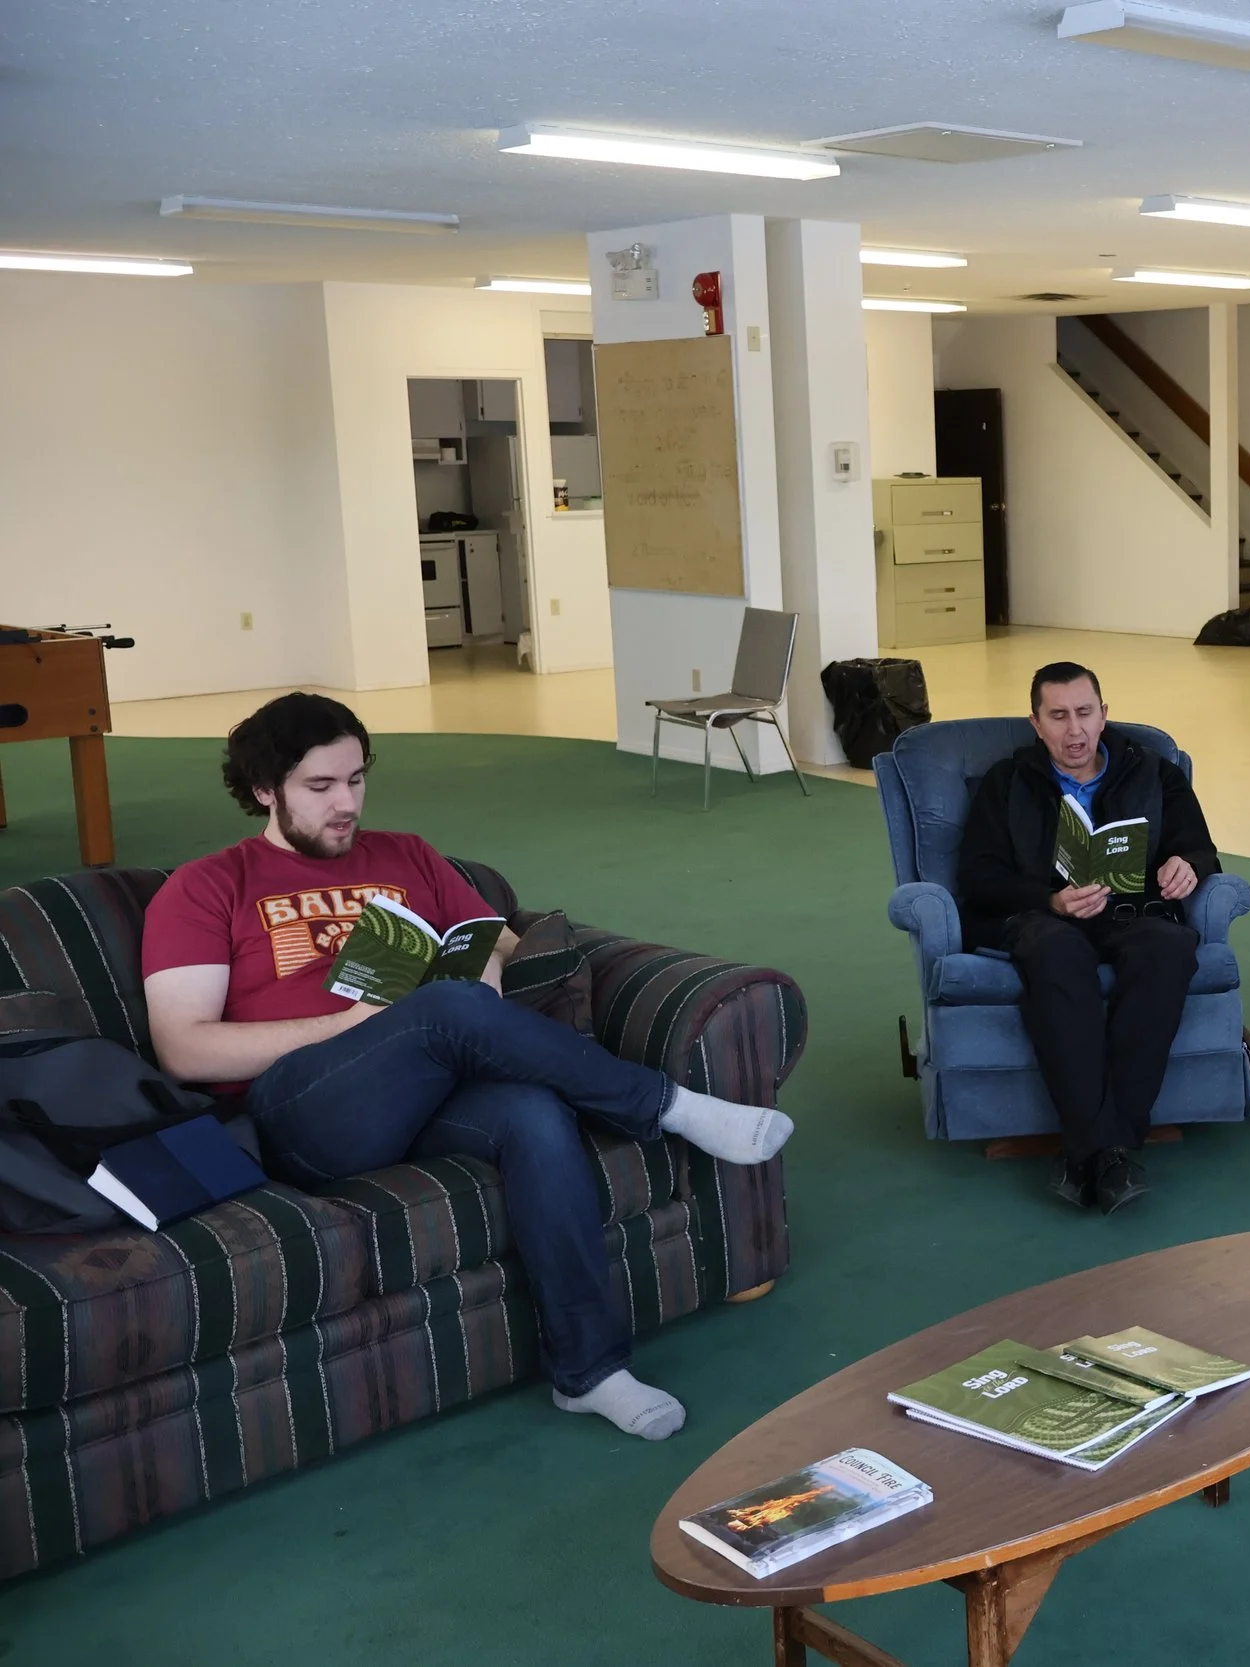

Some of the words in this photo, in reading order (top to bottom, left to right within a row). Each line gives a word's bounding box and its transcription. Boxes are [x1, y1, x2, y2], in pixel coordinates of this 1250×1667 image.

[1108, 836, 1128, 846] Sing
[1106, 845, 1129, 855] LORD
[448, 932, 472, 945] Sing
[442, 944, 470, 957] LORD
[962, 1369, 1008, 1389] Sing
[982, 1376, 1029, 1399] LORD
[839, 1456, 879, 1477] COUNCIL
[876, 1472, 903, 1489] FIRE
